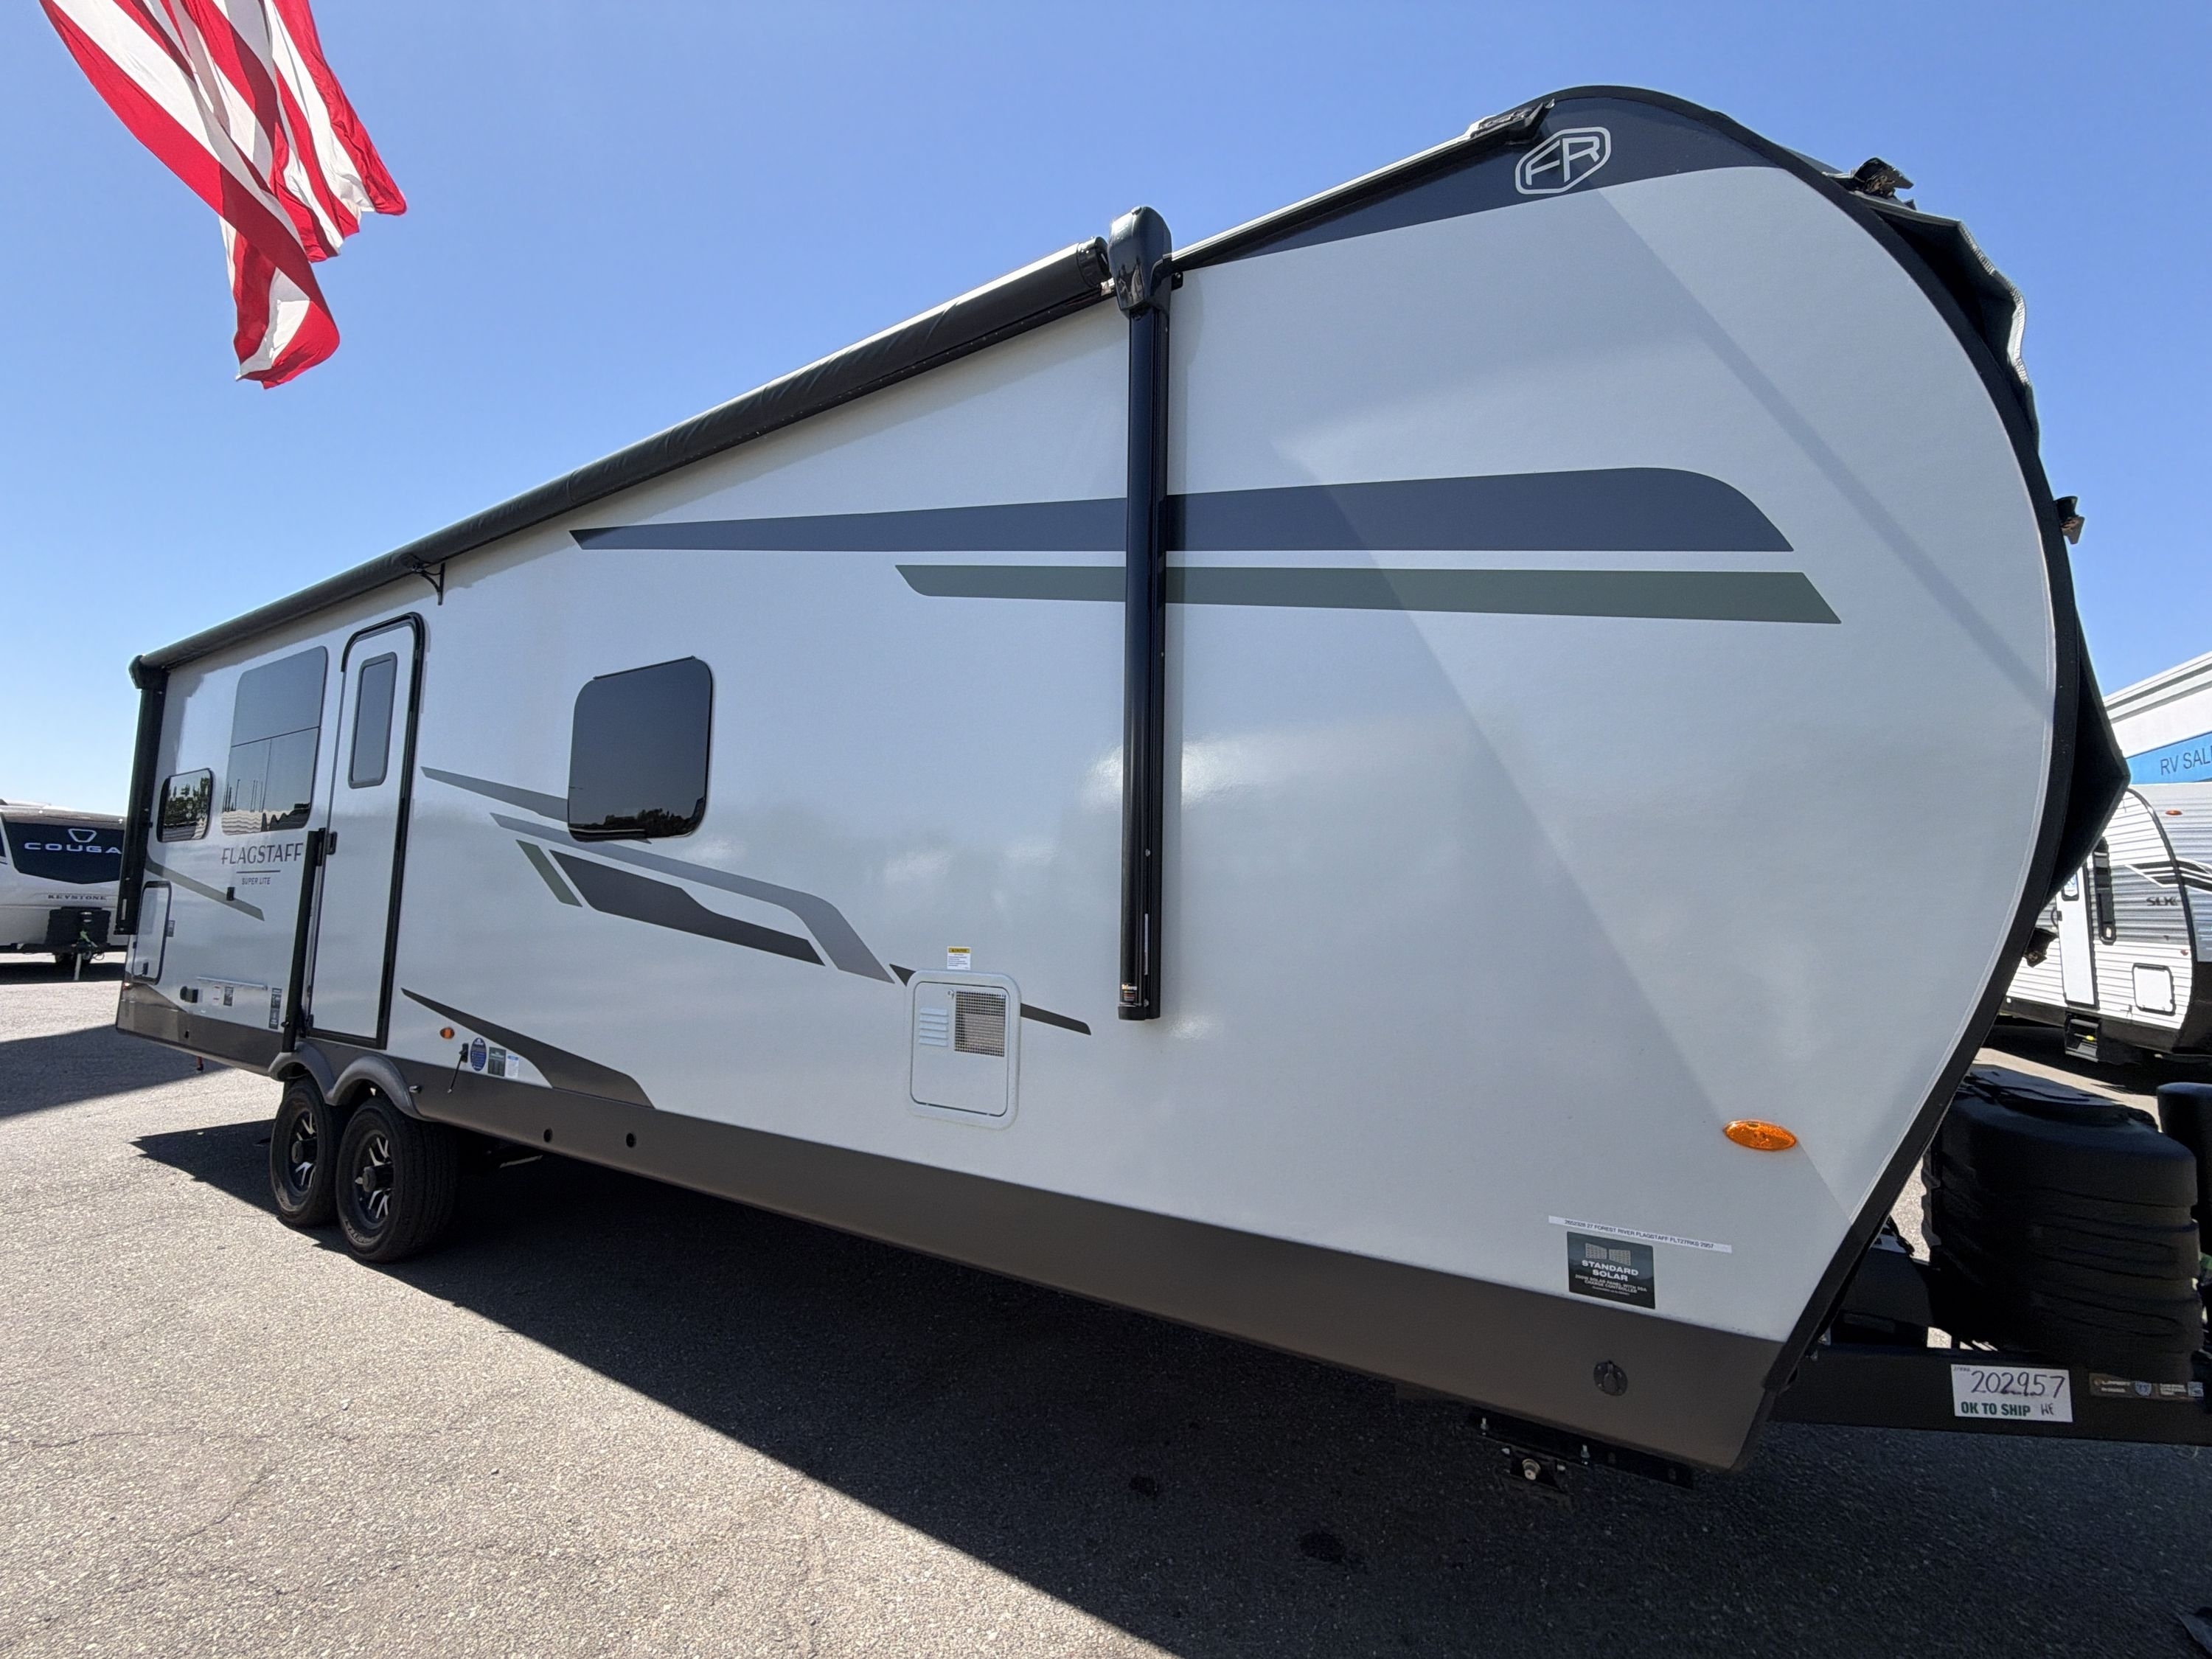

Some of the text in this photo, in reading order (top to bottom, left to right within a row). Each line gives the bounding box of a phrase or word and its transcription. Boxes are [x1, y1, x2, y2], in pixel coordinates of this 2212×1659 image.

[2160, 745, 2212, 776] RV SAL
[221, 843, 304, 865] FLAGSTAFF
[241, 877, 258, 886] SUPER
[1594, 1225, 1616, 1233] FOREST
[1636, 1231, 1669, 1241] FLAGSTAFF
[1582, 1259, 1638, 1276] STANDARD
[1592, 1269, 1628, 1281] SOLAR
[1970, 1369, 2066, 1399] 202957
[1961, 1401, 2031, 1416] OK TO SHIP
